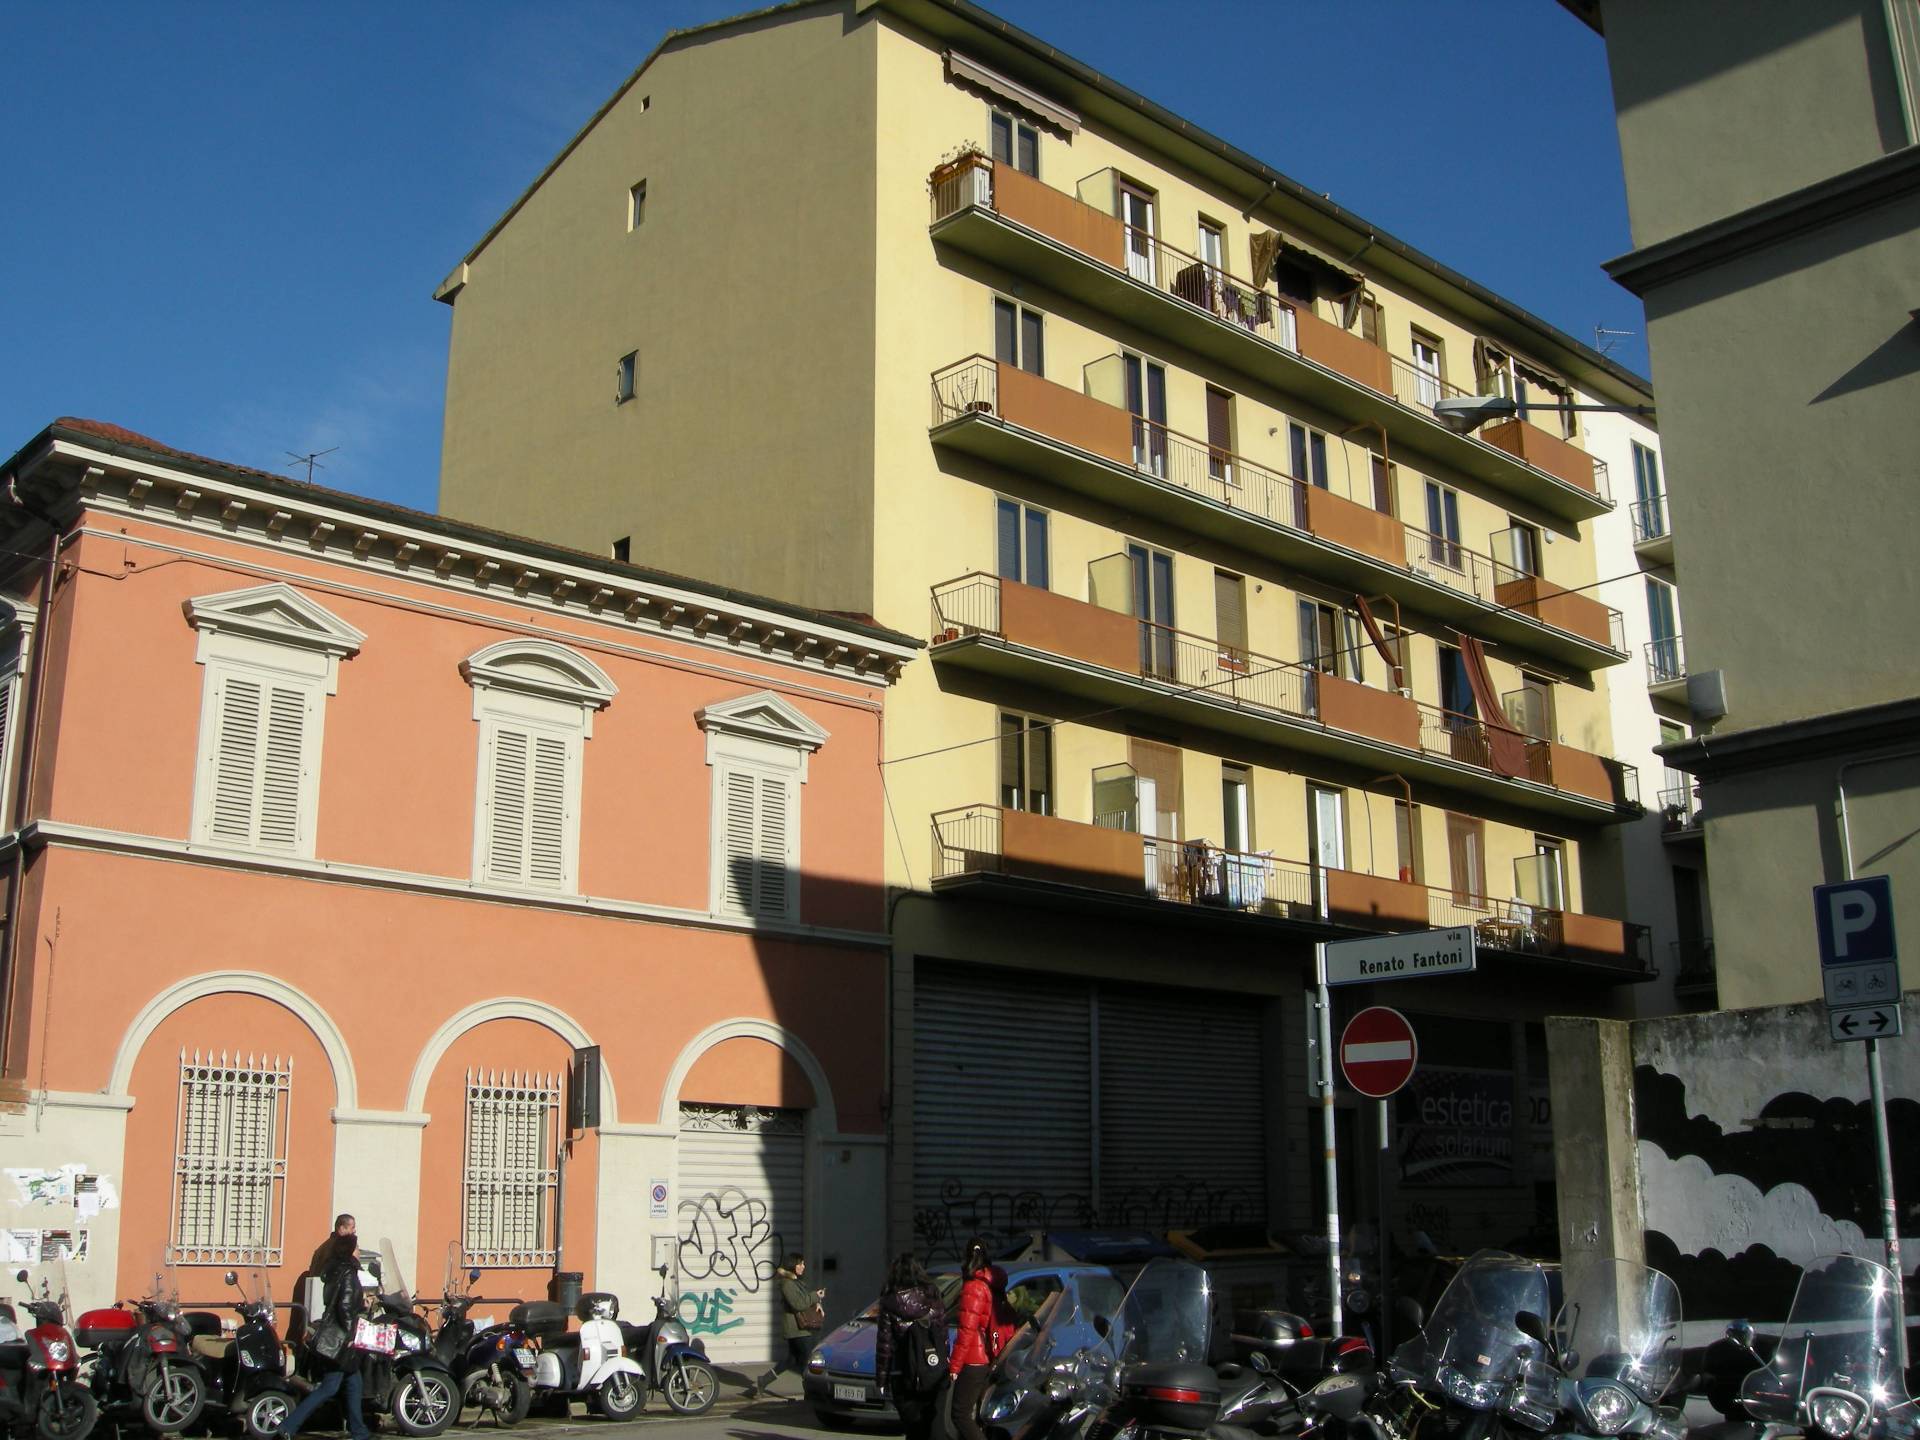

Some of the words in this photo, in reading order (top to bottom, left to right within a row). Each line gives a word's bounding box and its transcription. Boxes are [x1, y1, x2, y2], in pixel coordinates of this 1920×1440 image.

[1446, 933, 1462, 942] via
[1829, 889, 1877, 957] P
[1359, 958, 1405, 976] Renato
[1412, 947, 1463, 969] Fantoni
[1421, 1089, 1513, 1128] estetica
[1436, 1130, 1512, 1157] solarium
